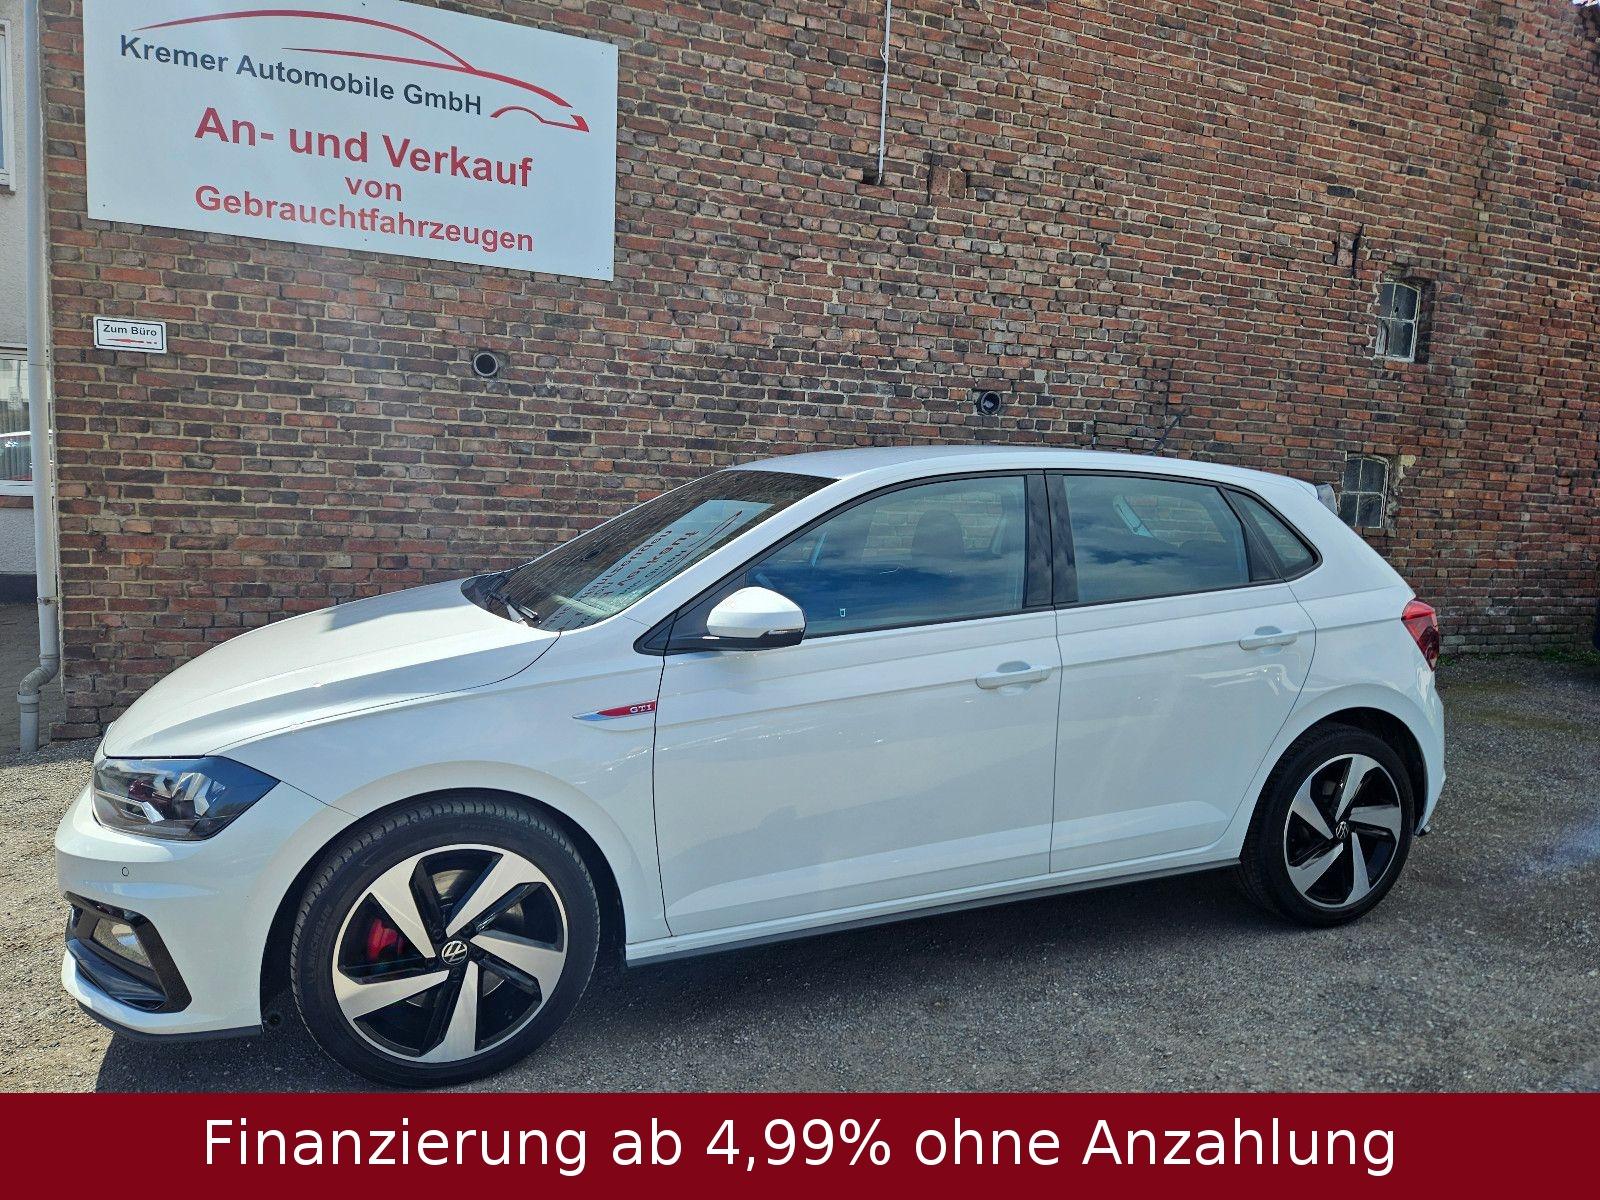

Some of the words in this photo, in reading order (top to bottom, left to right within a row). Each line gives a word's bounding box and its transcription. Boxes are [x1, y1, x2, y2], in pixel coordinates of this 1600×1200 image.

[121, 34, 229, 72] Kremer
[235, 54, 395, 101] Automobile
[403, 83, 482, 116] GmbH
[194, 107, 274, 146] An-
[289, 129, 368, 163] und
[381, 134, 533, 187] Verkauf
[344, 176, 403, 202] von
[195, 185, 534, 253] Gebrauchtfahrzeugen
[103, 324, 128, 334] Zum
[131, 326, 157, 337] Büro
[629, 704, 652, 713] GTI
